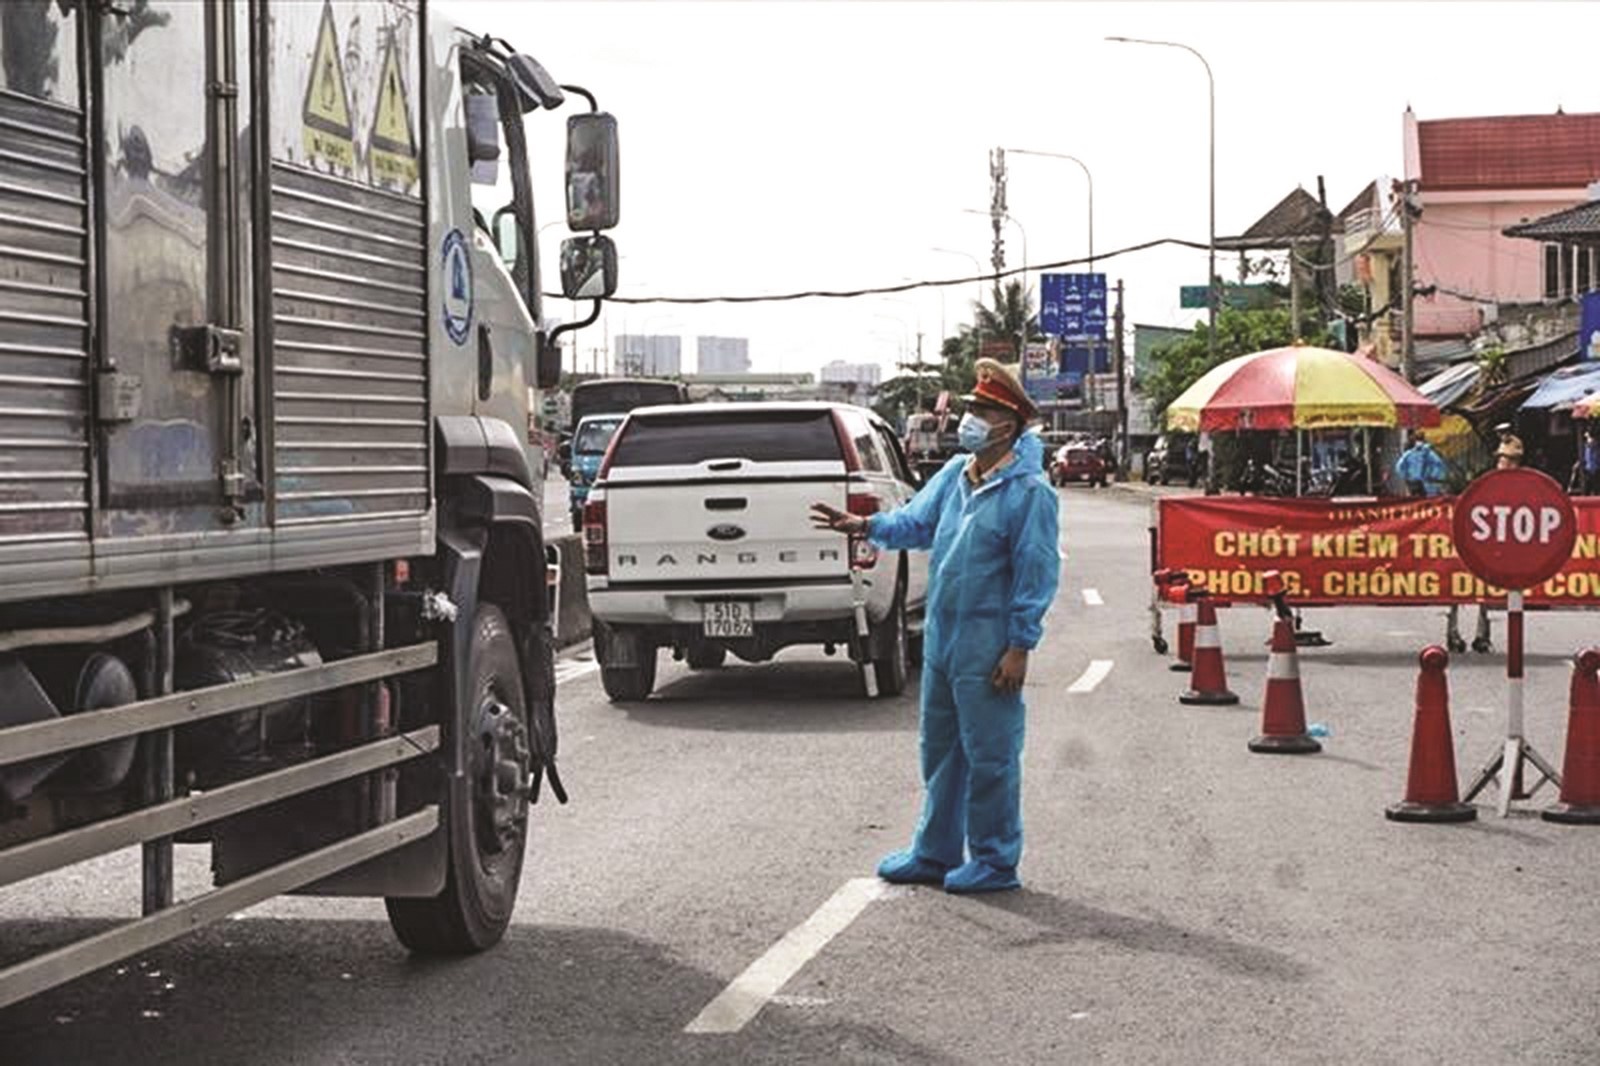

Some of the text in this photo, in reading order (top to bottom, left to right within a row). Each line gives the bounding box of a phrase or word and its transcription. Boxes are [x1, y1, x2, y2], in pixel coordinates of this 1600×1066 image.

[1470, 505, 1562, 544] STOP
[617, 549, 839, 567] RANGER
[1214, 525, 1459, 558] CHỐT KIỂM TR
[1322, 563, 1441, 597] CHỐNG
